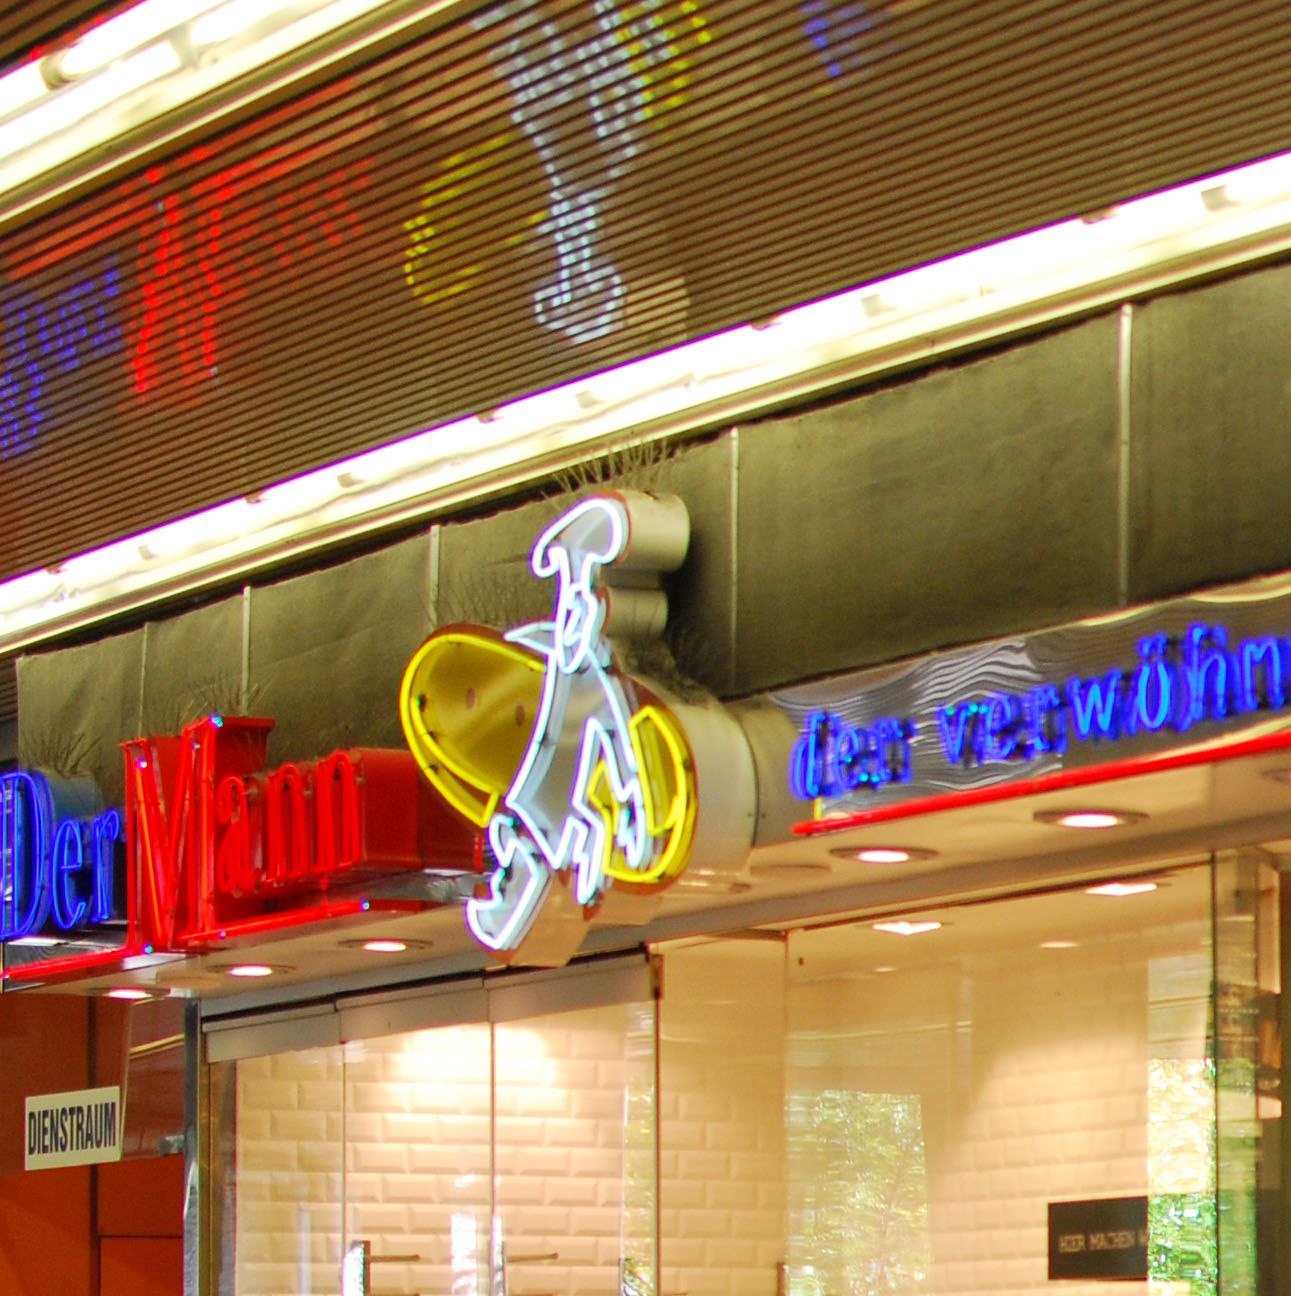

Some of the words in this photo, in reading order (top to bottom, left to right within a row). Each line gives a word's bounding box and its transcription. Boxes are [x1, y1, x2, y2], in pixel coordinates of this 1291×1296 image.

[789, 705, 911, 800] der
[0, 770, 121, 938] Der
[120, 716, 366, 952] Mann
[27, 1101, 118, 1156] DIENSTRAUM
